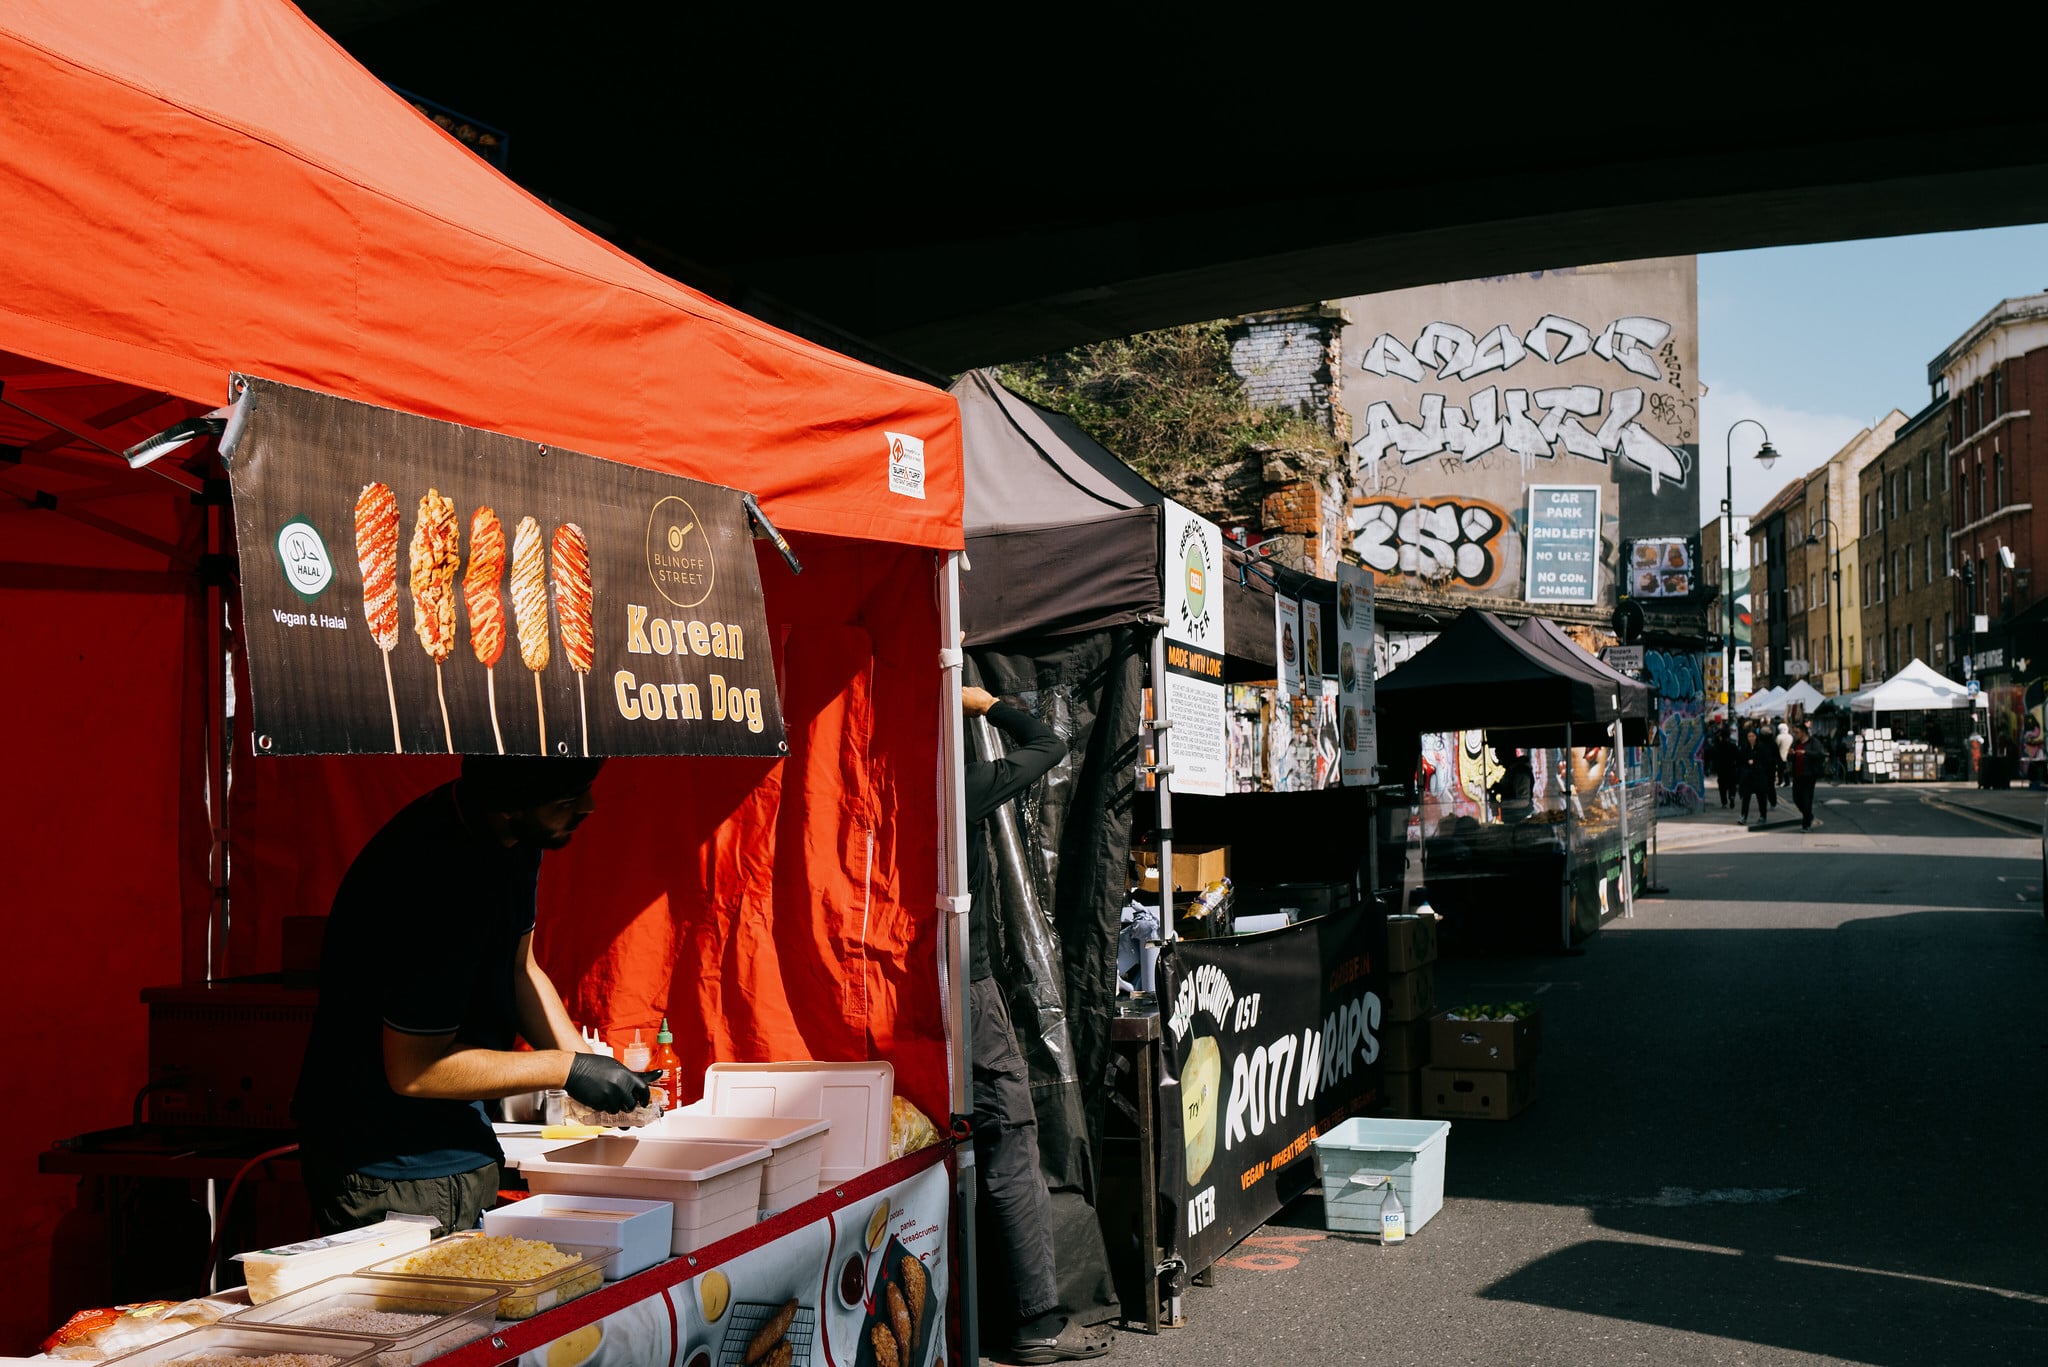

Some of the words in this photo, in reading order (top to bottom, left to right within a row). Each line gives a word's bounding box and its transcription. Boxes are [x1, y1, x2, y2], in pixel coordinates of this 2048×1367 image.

[1551, 493, 1579, 503] CAR
[1547, 508, 1582, 518] PARK
[1534, 527, 1561, 538] 2ND
[1562, 528, 1595, 539] LEFT
[1191, 518, 1211, 571] COCONUT
[655, 553, 704, 570] BLINOFF
[1536, 551, 1553, 560] NO
[1558, 552, 1590, 561] ULEZ
[297, 565, 321, 577] HALAL
[659, 570, 703, 585] STREET
[1537, 572, 1556, 582] NO
[1559, 573, 1587, 583] CON.
[1538, 586, 1585, 596] CHARGE
[272, 608, 307, 627] Vegan
[309, 613, 318, 627] &
[320, 614, 348, 629] Halal
[1181, 599, 1210, 642] WATER
[627, 604, 744, 660] Korean
[1168, 645, 1188, 669] MADE
[1189, 651, 1206, 674] WITH
[1206, 656, 1221, 678] LOVE
[614, 670, 702, 721] Corn
[709, 674, 764, 734] Dog
[1224, 1034, 1298, 1150] ROTI
[1298, 991, 1381, 1107] WRAPS
[1240, 1161, 1265, 1191] VEGAN
[1271, 1142, 1295, 1171] WHEAT
[1294, 1131, 1308, 1156] FREE
[889, 1208, 904, 1222] potato
[900, 1218, 917, 1233] panko
[902, 1224, 939, 1245] breadcrumbs
